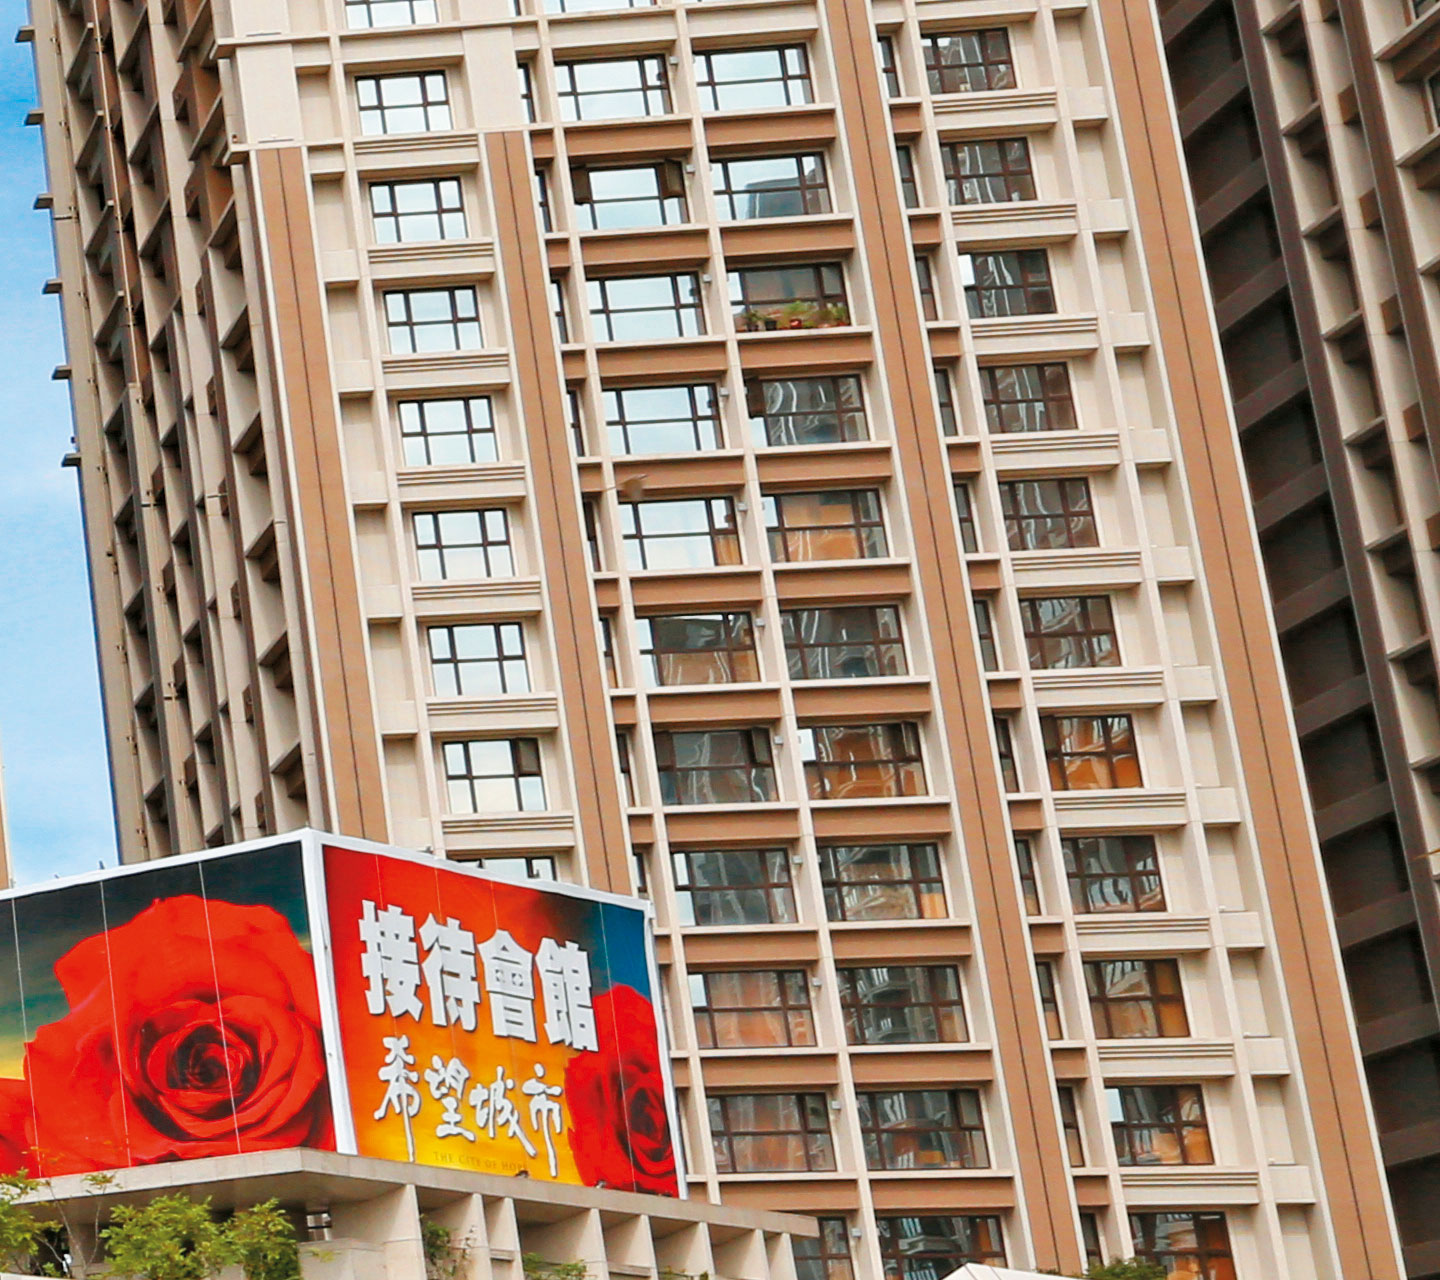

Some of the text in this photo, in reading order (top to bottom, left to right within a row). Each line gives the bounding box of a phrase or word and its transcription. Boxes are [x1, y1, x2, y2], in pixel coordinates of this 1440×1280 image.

[358, 899, 599, 1052] 接待會館
[373, 1034, 563, 1177] 希望城市
